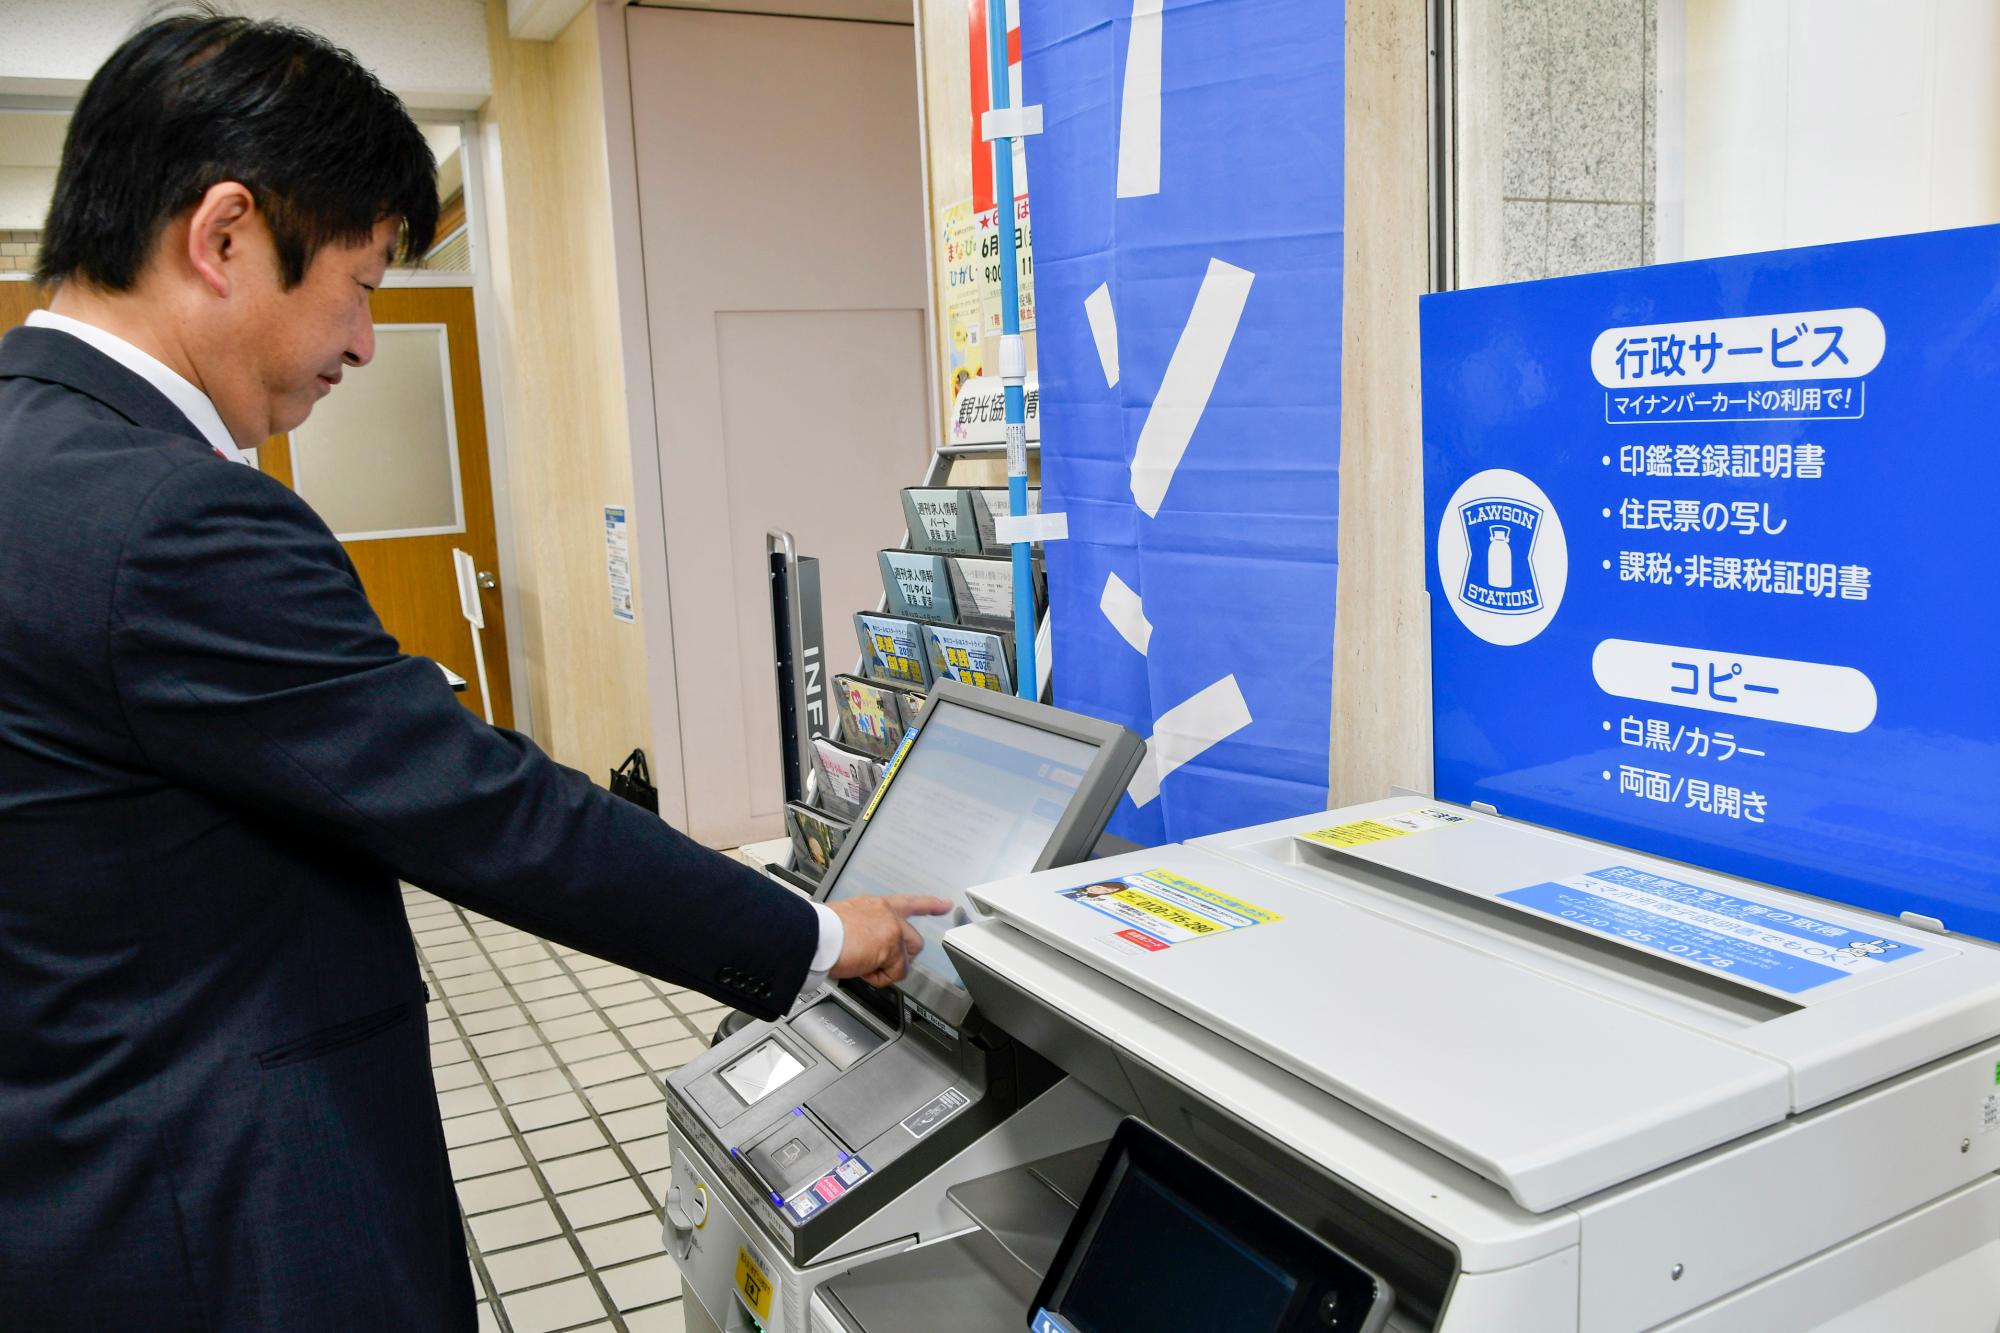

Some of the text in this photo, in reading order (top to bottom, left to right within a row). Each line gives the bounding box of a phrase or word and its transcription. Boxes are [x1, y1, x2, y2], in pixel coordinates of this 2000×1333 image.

[1615, 322, 1850, 380] 行政サービス
[1613, 387, 1852, 415] マイナンバーカードの利用で!
[1619, 443, 1826, 481] 印鑑登録証明書
[1465, 503, 1537, 530] LAWSON
[1619, 499, 1788, 536] 住民票の写し
[1619, 551, 1872, 602] 課税・非課税証明書
[1466, 584, 1536, 608] STATION
[1671, 661, 1779, 703] コピー
[1620, 715, 1766, 761] 白黒/カラー
[1619, 764, 1768, 823] 両面/見開き
[1136, 900, 1214, 934] 0120-715-280
